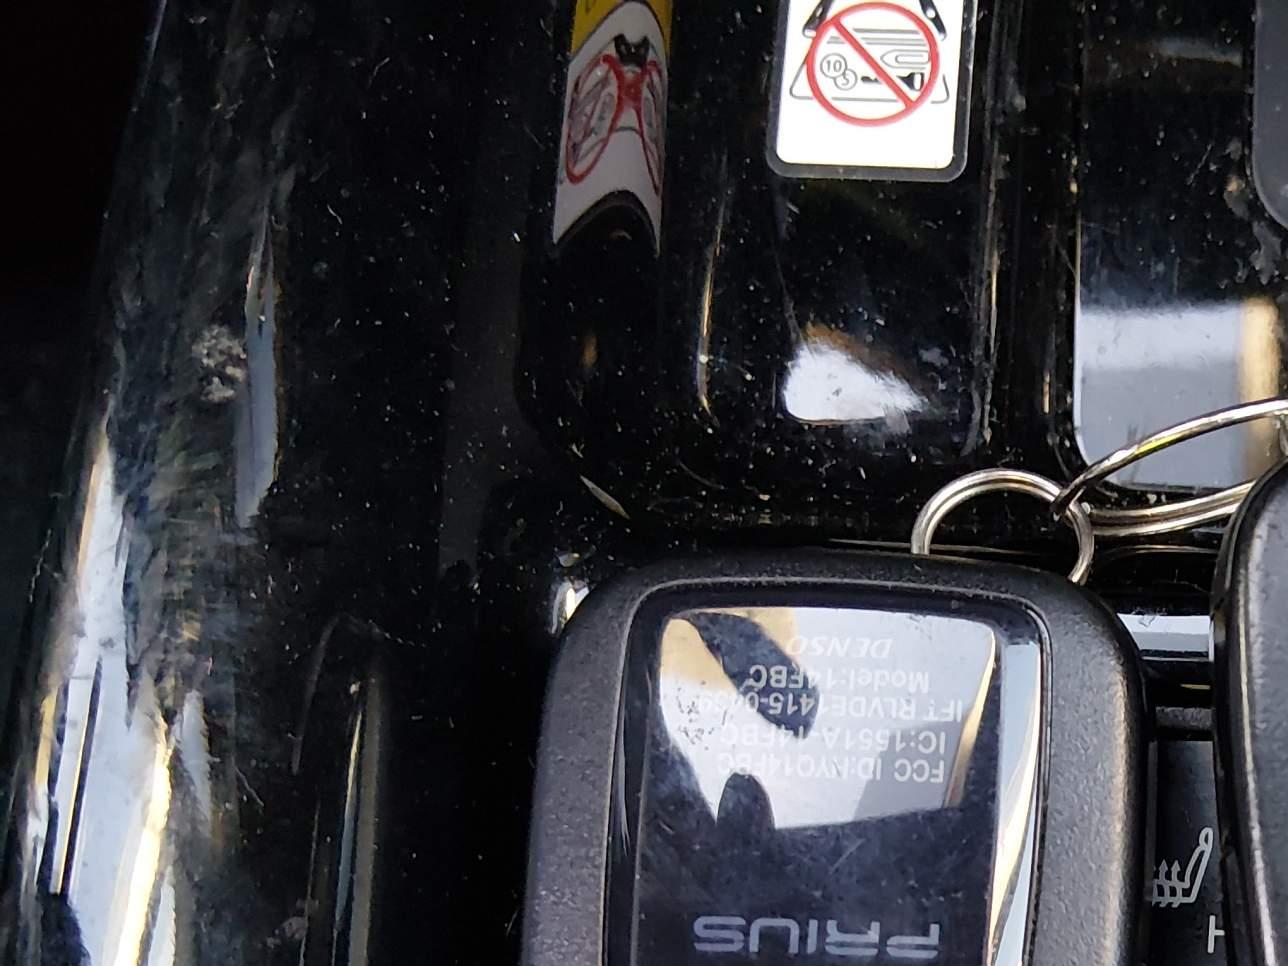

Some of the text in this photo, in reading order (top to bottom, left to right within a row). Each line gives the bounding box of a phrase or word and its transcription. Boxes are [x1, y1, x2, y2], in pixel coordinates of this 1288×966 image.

[826, 59, 842, 73] 10
[784, 635, 893, 659] DENSO
[748, 664, 929, 694] Model:14FBC
[922, 699, 962, 723] IFT
[893, 758, 945, 783] FCC
[693, 915, 941, 959] PRIUS
